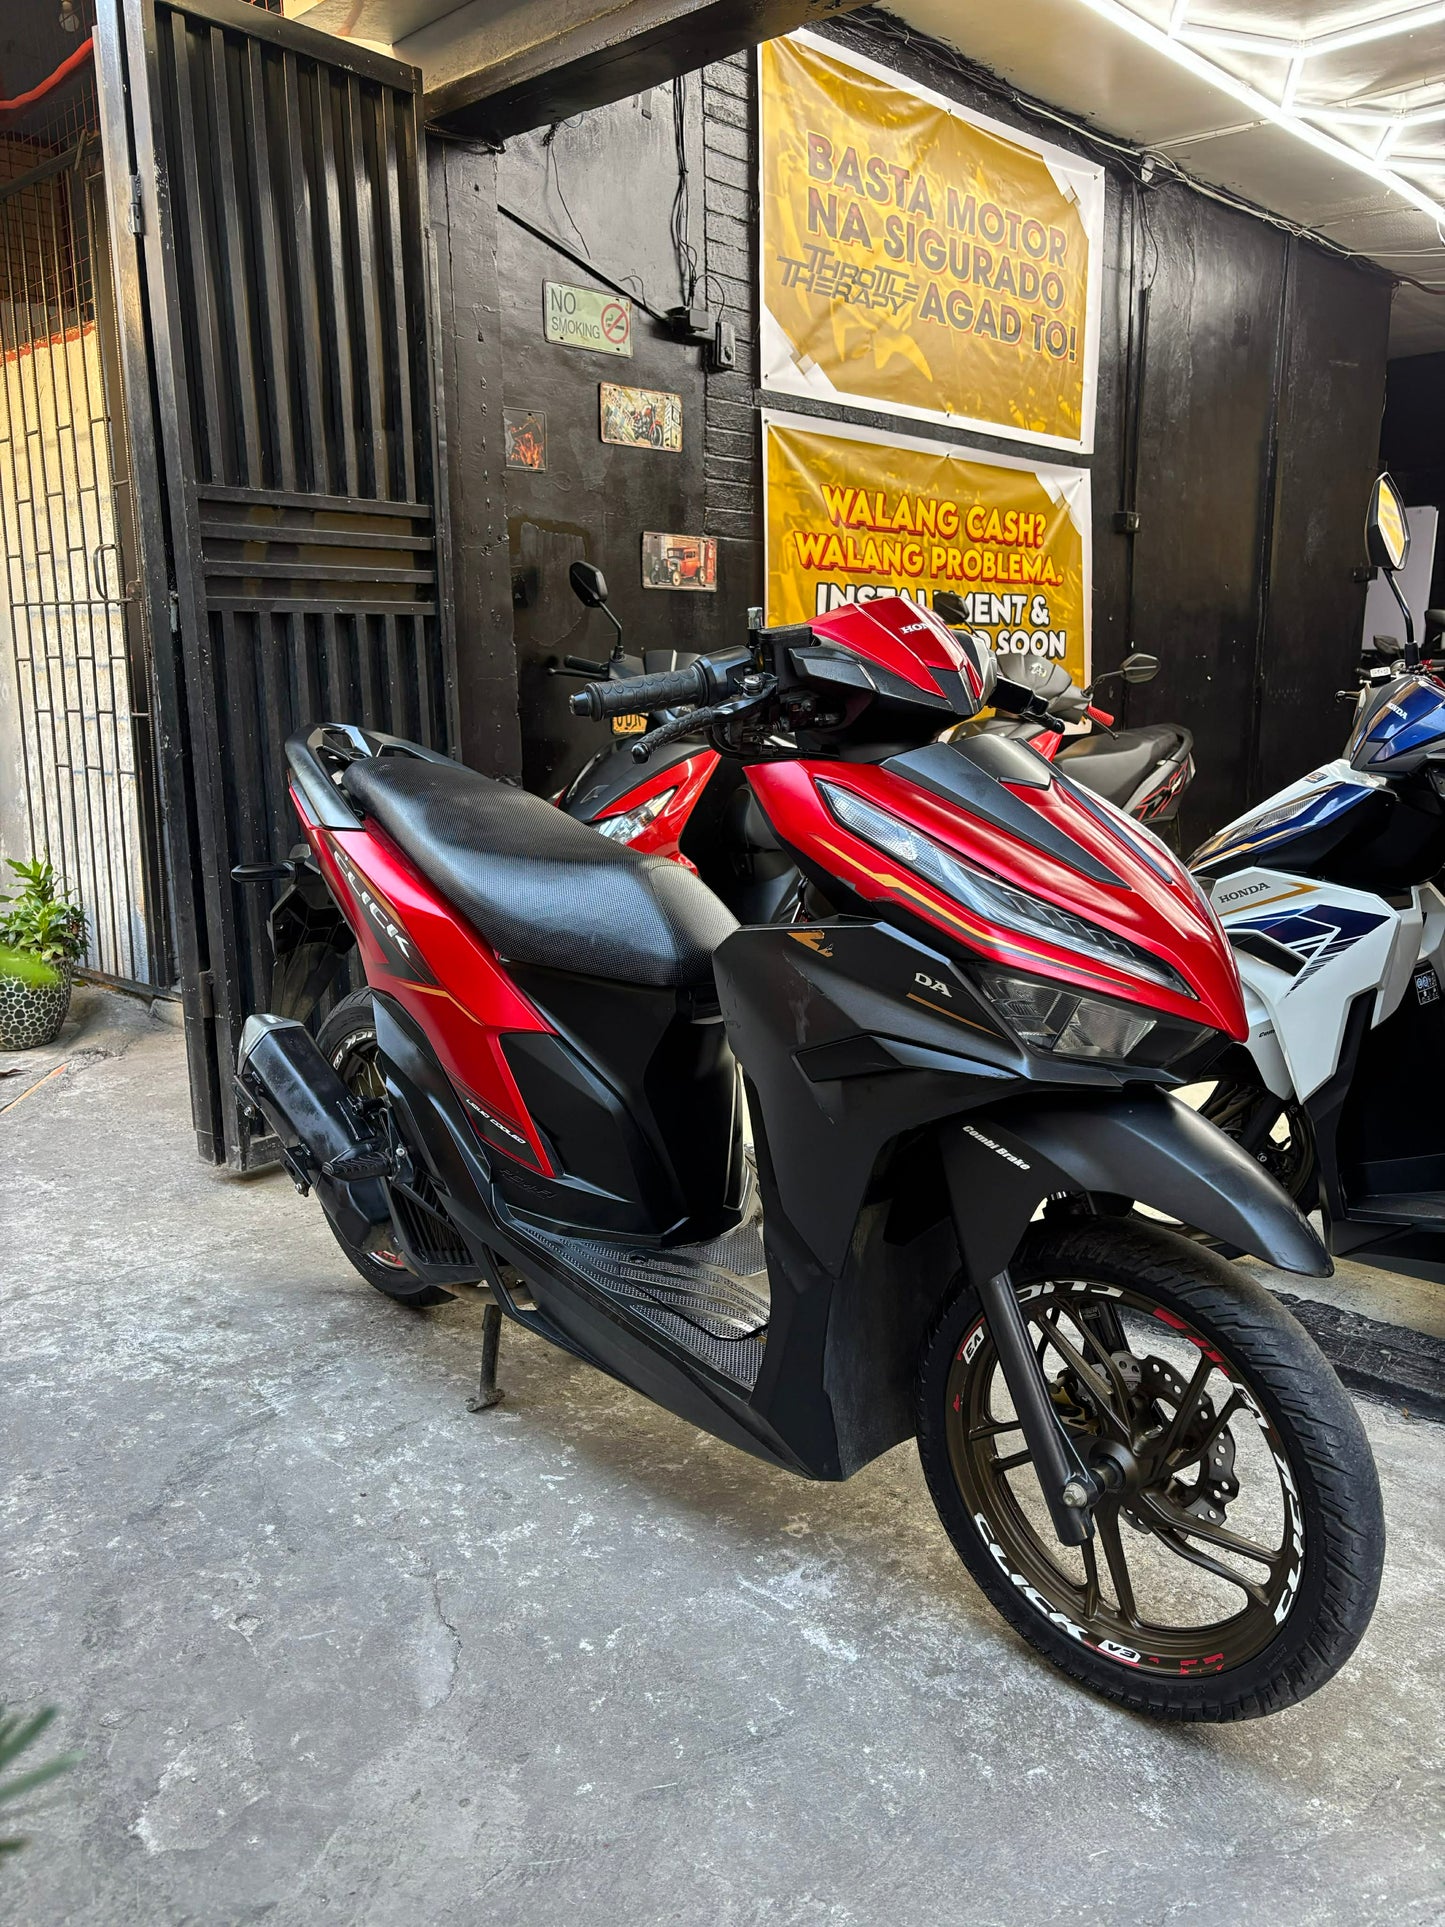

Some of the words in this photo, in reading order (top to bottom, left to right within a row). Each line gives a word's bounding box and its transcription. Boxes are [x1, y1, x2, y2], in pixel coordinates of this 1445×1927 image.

[806, 130, 937, 223] BASTA
[946, 186, 1067, 268] MOTOR
[802, 243, 921, 304] THROTTLE
[806, 185, 875, 252] NA
[883, 214, 1066, 313] SIGURADO
[551, 287, 577, 315] NO
[776, 255, 908, 316] THERAPY
[551, 316, 601, 339] SMOKING
[918, 281, 1023, 346] AGAD
[1030, 312, 1078, 363] TO!
[820, 484, 961, 540] WALANG
[965, 504, 1048, 549] CASH?
[794, 531, 926, 578] WALANG
[929, 544, 1065, 587] PROBLEMA.
[1030, 594, 1051, 627] &
[994, 629, 1069, 659] SOON
[333, 850, 411, 958] CLICK
[1218, 881, 1271, 904] HONDA
[490, 1118, 527, 1144] COOLED
[962, 1124, 1000, 1150] Combi
[995, 1147, 1031, 1170] Brake
[1016, 1280, 1125, 1304] CLIC
[973, 1512, 1089, 1641] CLICK
